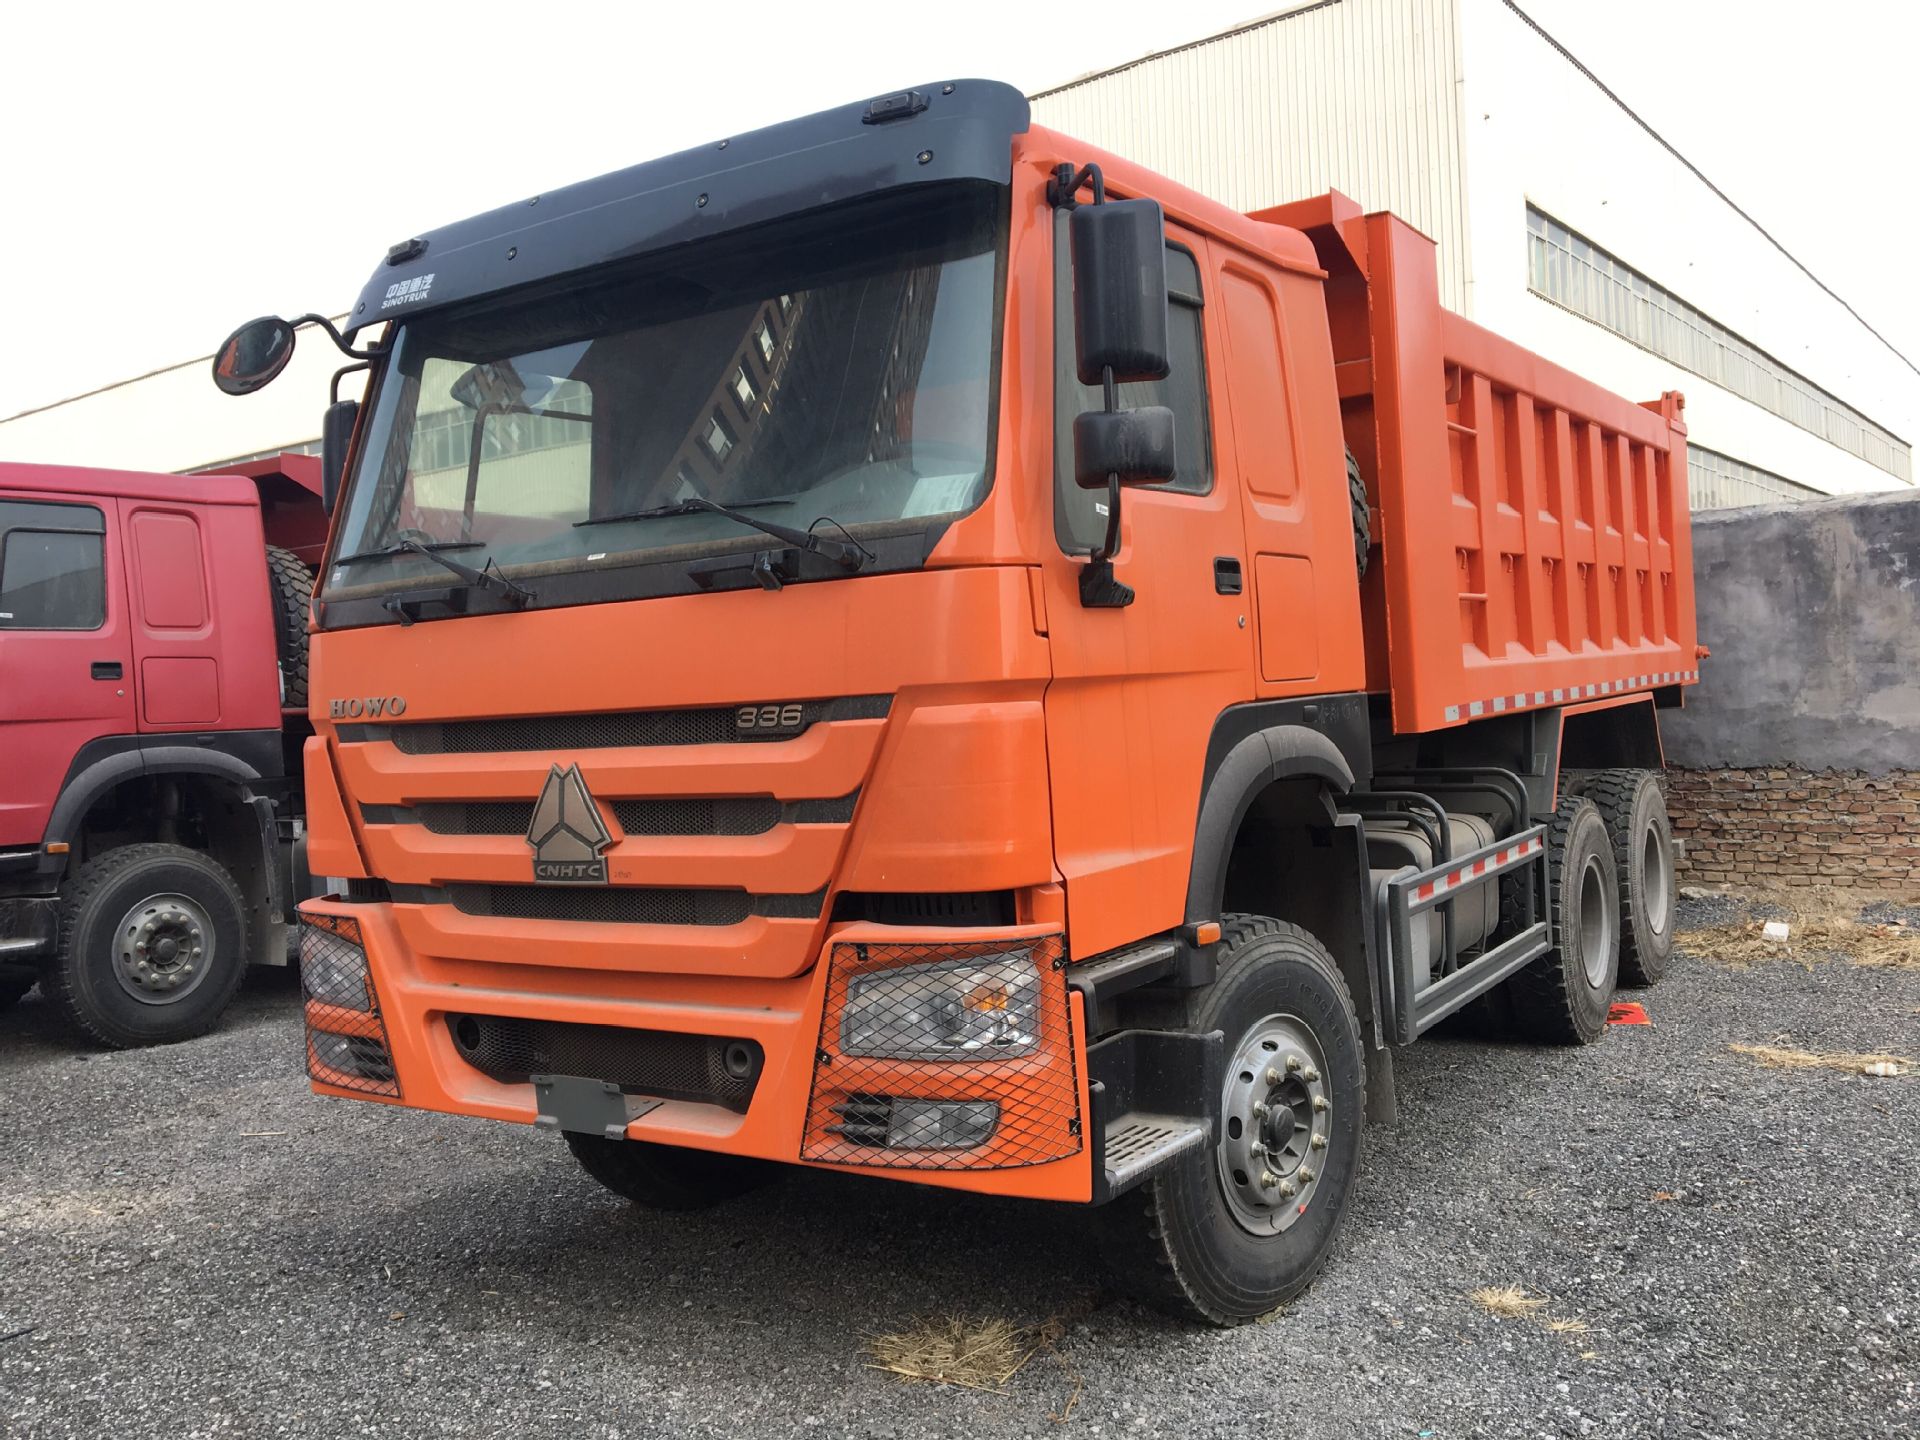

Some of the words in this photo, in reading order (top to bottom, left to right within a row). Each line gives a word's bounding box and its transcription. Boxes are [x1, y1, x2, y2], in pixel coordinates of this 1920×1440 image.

[381, 289, 430, 309] SINOTRUK
[329, 696, 406, 719] HOWO
[737, 704, 802, 728] 336
[537, 864, 601, 878] CNHTC
